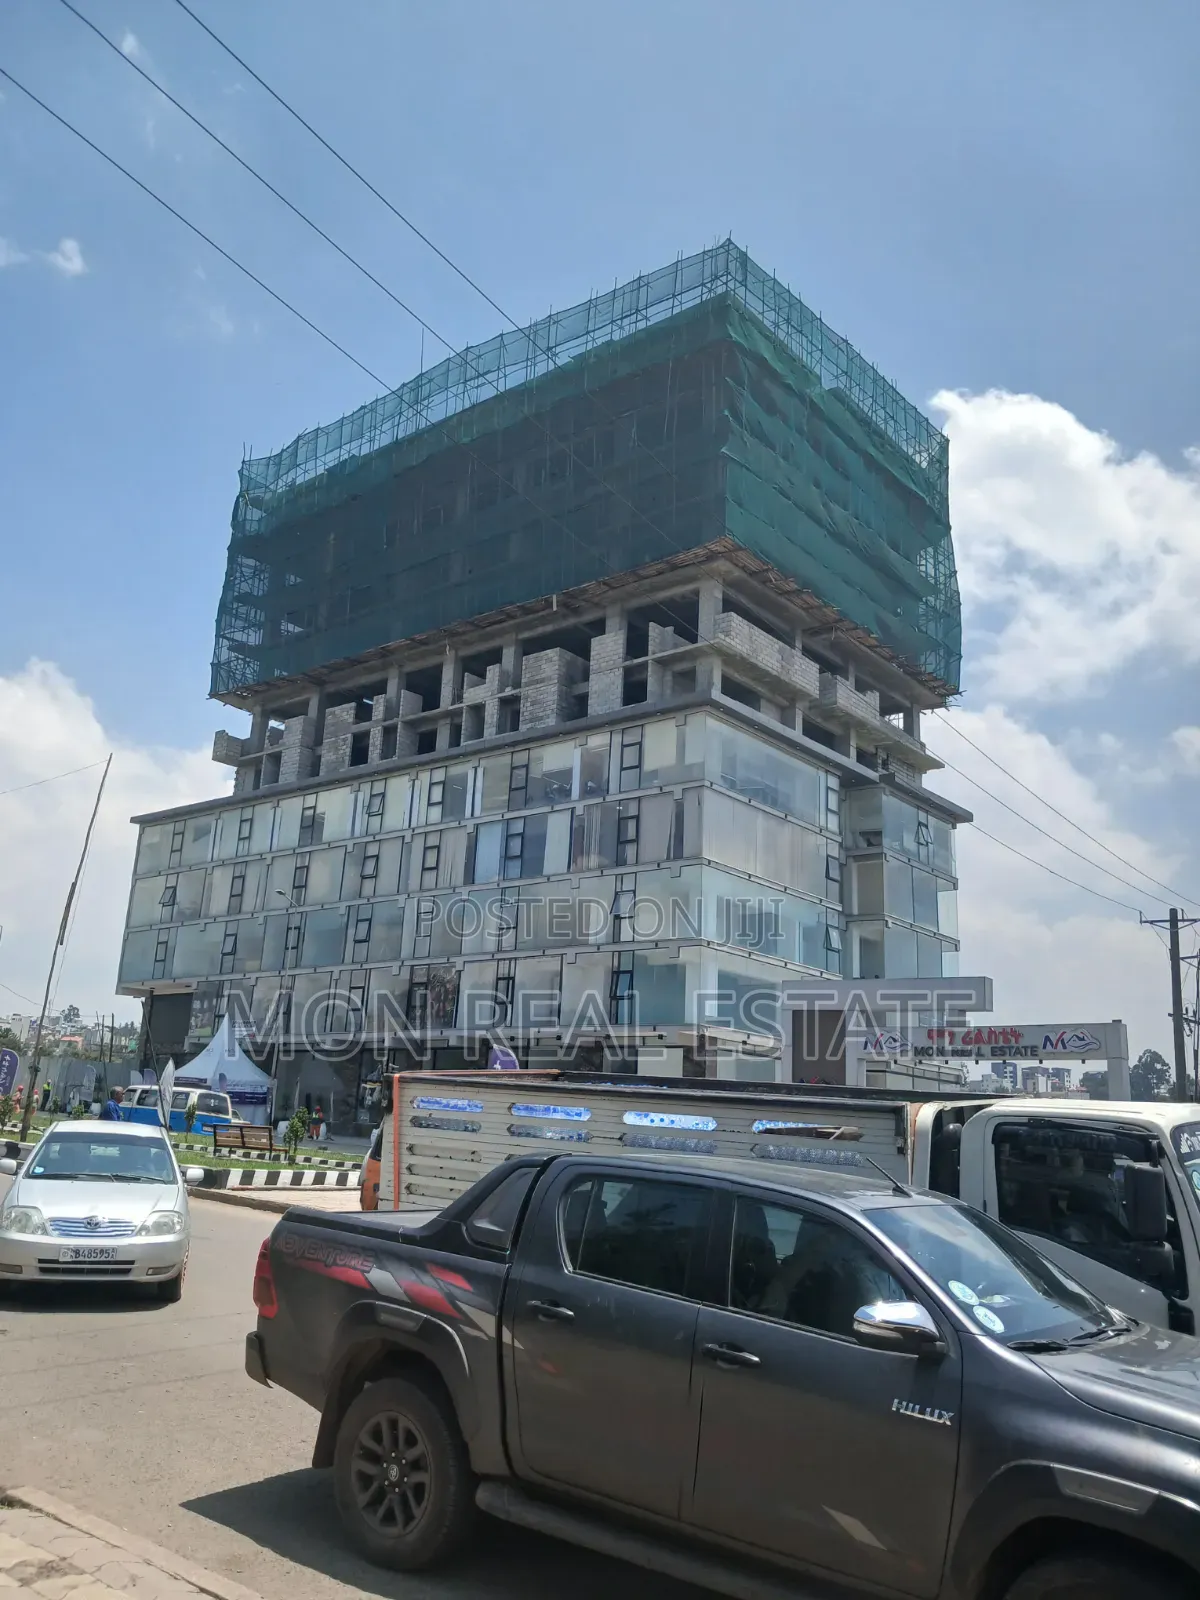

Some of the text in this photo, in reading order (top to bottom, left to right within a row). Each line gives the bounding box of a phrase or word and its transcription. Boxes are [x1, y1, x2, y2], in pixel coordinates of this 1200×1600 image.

[913, 1045, 946, 1058] MON
[990, 1045, 1039, 1058] ESTATE
[891, 1398, 955, 1426] HILUX
